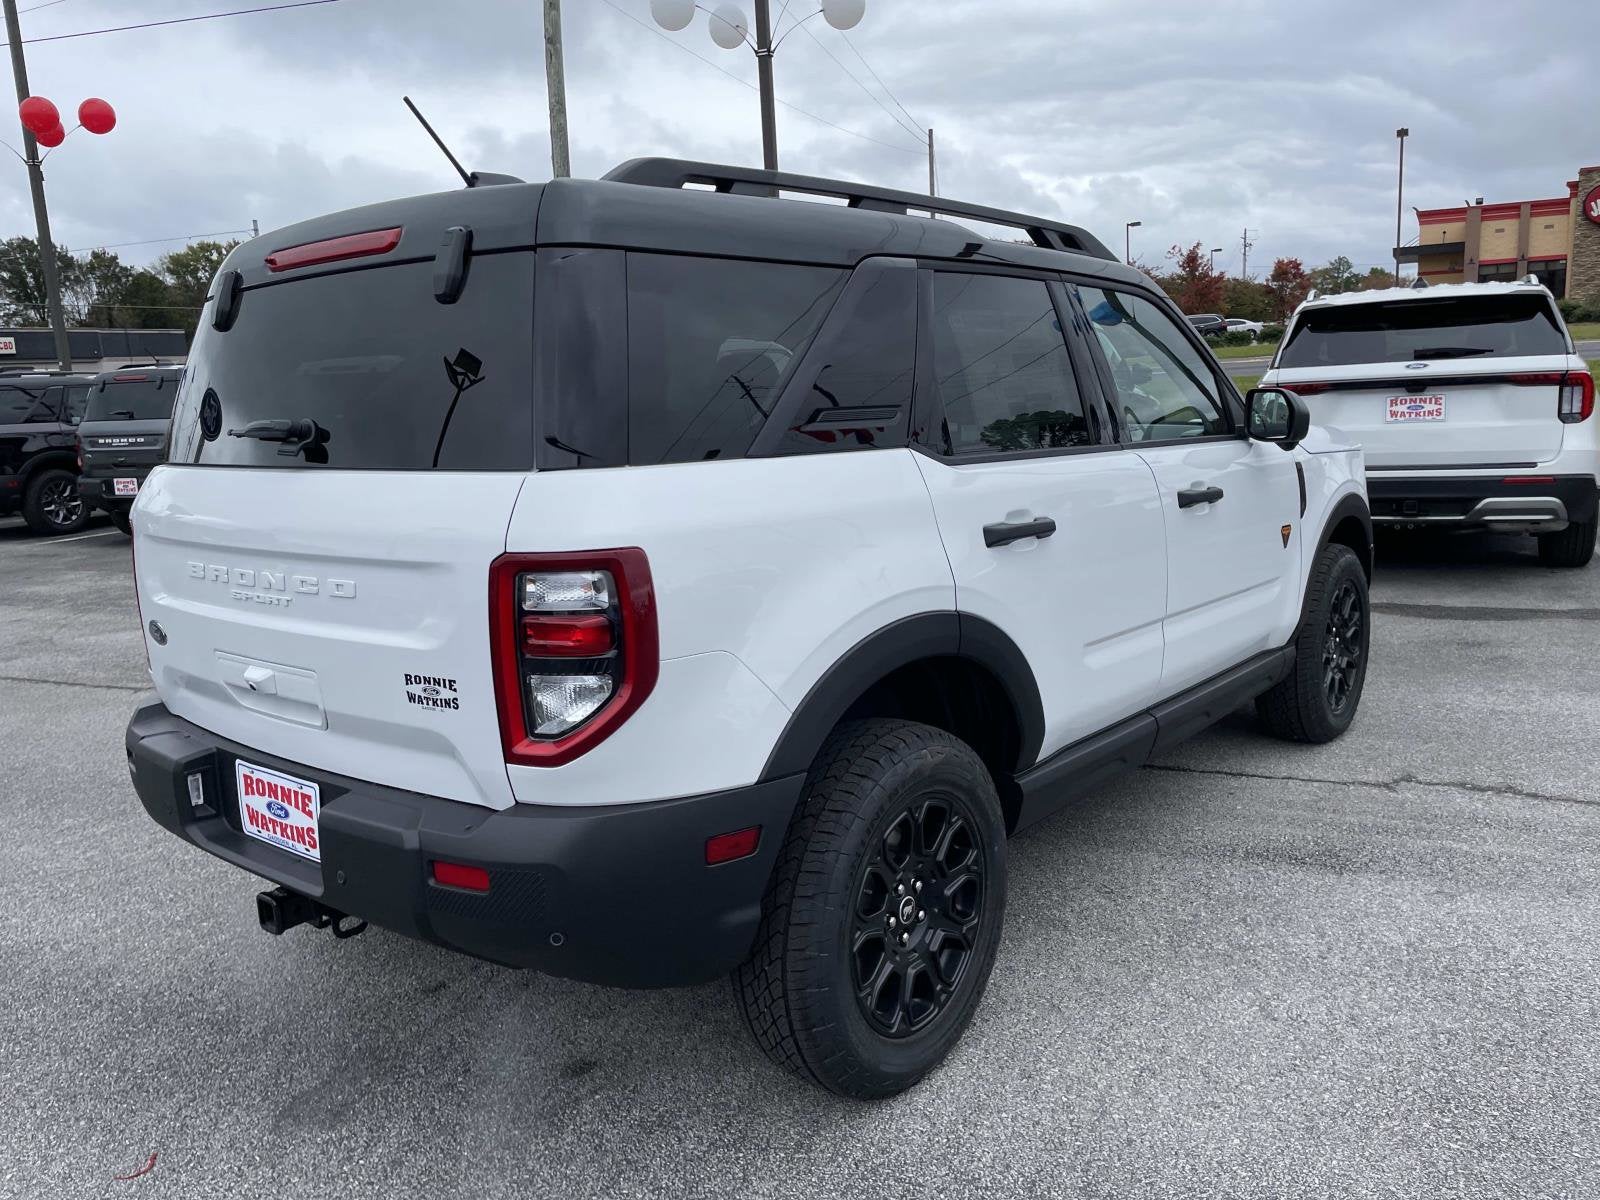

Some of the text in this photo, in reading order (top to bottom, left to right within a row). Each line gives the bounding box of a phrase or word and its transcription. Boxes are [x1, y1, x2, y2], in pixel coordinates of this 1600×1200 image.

[1389, 396, 1443, 408] RONNIE
[1389, 408, 1443, 419] WATKINS
[186, 561, 357, 600] BRONCO
[231, 589, 294, 608] SPORT
[404, 673, 458, 694] RONNIE
[406, 690, 460, 710] WATKINS
[242, 773, 314, 820] RONNIE
[245, 803, 318, 850] WATKINS
